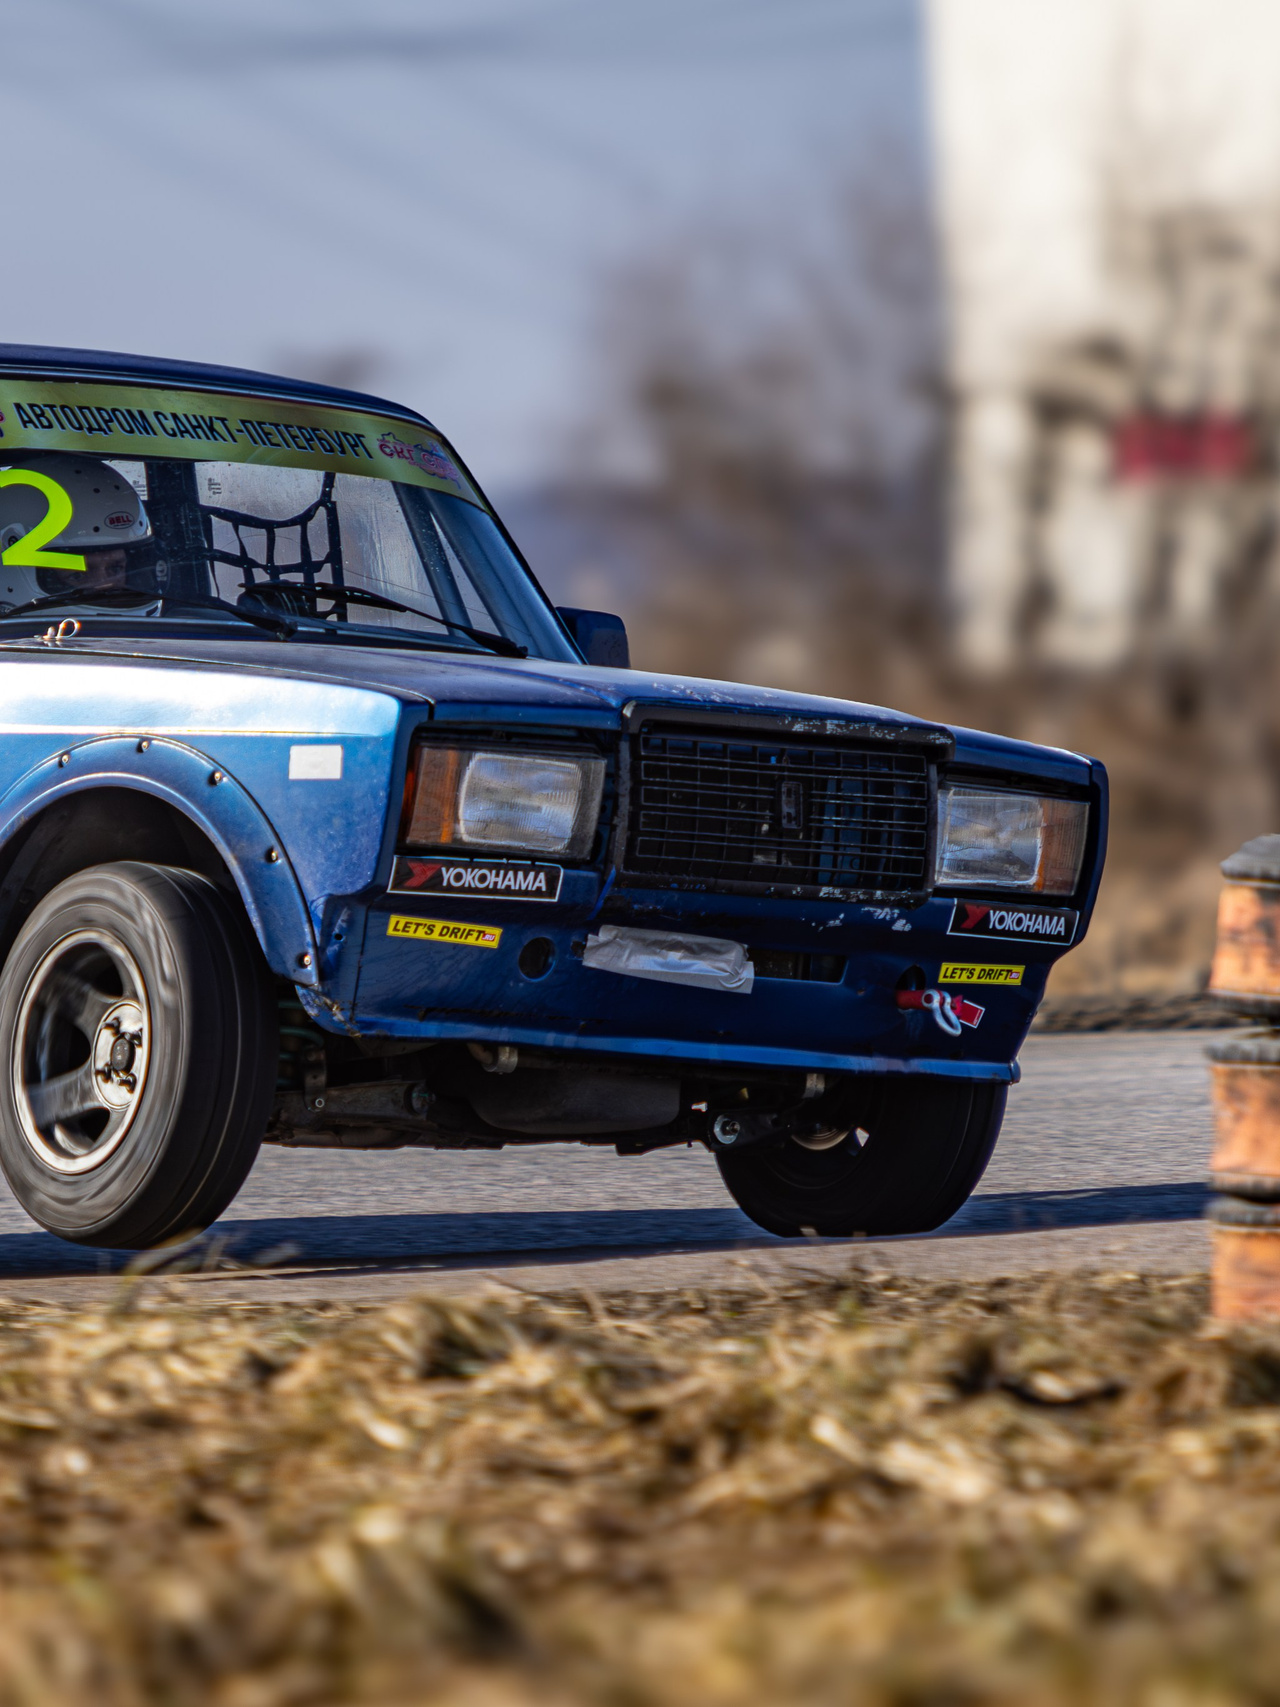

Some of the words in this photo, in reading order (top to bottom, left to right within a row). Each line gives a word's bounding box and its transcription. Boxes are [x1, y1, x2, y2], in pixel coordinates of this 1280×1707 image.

[13, 402, 158, 437] АВТОДРОМ
[153, 410, 374, 460] САНКТ-ПЕТЕРБУРГ
[108, 515, 133, 526] BELL
[441, 867, 547, 892] YOKOHAMA
[392, 920, 436, 936] LET'S
[988, 910, 1066, 936] YOKOHAMA
[942, 967, 975, 980] LET'S
